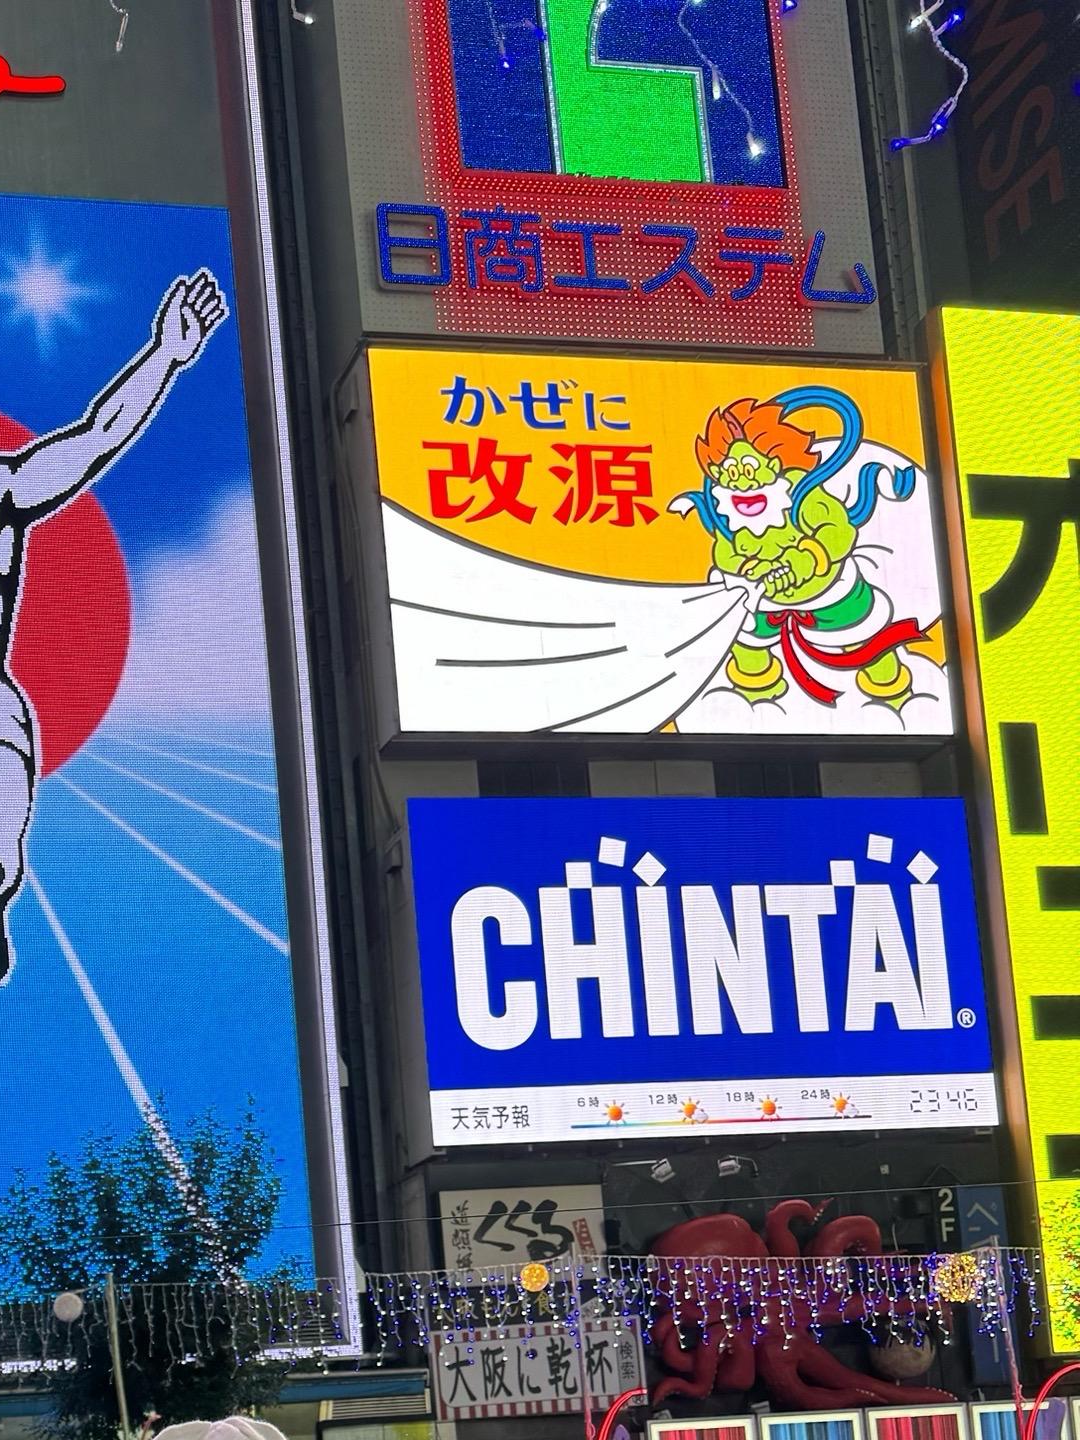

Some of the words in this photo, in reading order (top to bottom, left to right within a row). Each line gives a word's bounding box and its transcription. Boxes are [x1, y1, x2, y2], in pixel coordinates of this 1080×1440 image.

[375, 203, 877, 305] 日商エステム
[441, 376, 631, 431] かぜに
[422, 437, 660, 527] 改源
[451, 834, 953, 1050] CHINTAI
[451, 1105, 531, 1130] 天気予報
[577, 1096, 600, 1108] 6時
[648, 1092, 678, 1105] 12時
[725, 1091, 755, 1103] 18時
[800, 1089, 831, 1100] 24時
[473, 1199, 576, 1262] くくる
[938, 1188, 955, 1242] 2F
[446, 1335, 613, 1404] 大阪に乾杯
